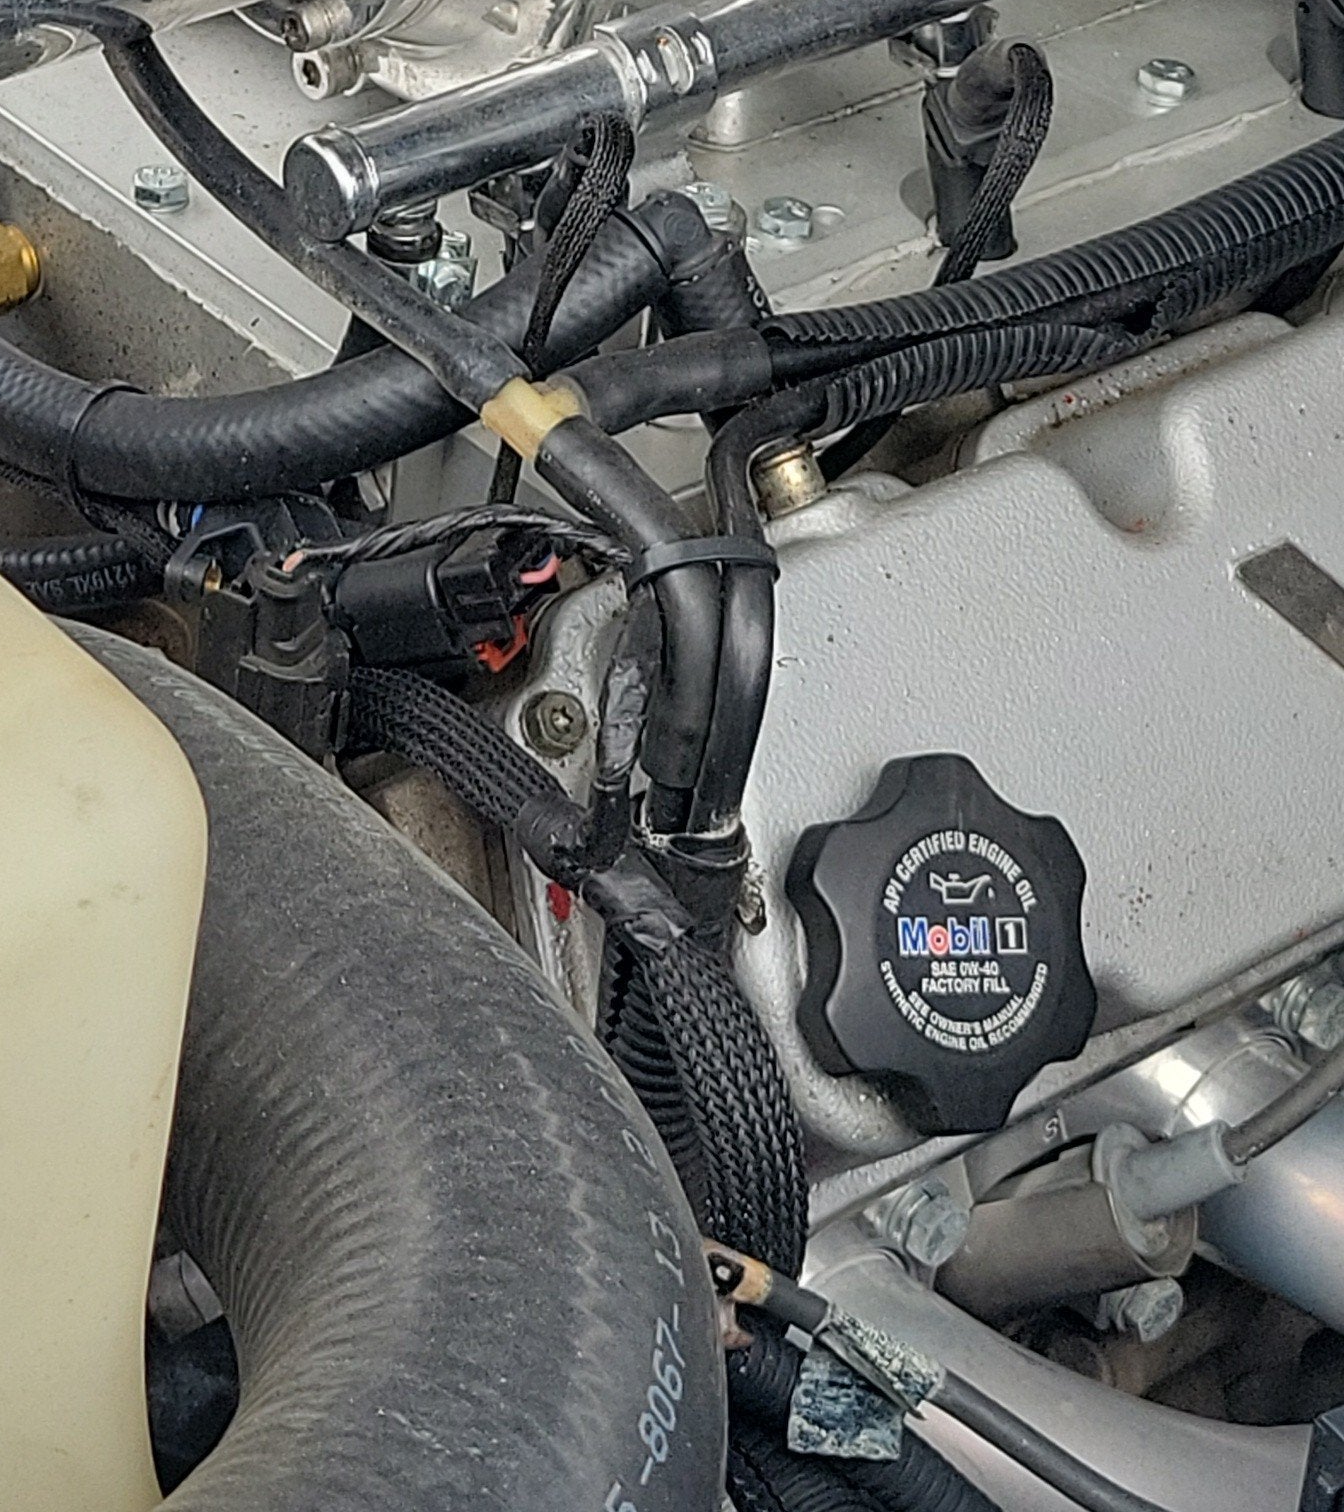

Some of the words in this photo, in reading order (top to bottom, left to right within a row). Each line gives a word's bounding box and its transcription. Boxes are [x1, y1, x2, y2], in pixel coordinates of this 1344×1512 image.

[882, 878, 905, 915] API
[895, 829, 966, 883] CERTIFIED
[967, 833, 1023, 884] ENGINE
[1014, 878, 1039, 914] OIL
[897, 916, 991, 956] Mobil
[921, 976, 981, 994] FACTORY
[982, 976, 1012, 994] FILL
[930, 960, 957, 977] SAE
[958, 960, 1001, 976] 0W-40
[879, 959, 927, 1032] SYNTHETIC
[923, 1022, 968, 1052] ENGINE
[967, 1035, 990, 1051] OIL
[987, 962, 1050, 1047] RECOMMENDED
[907, 990, 931, 1019] SEE
[928, 1010, 983, 1036] OWNER'S
[981, 993, 1025, 1034] MANUAL
